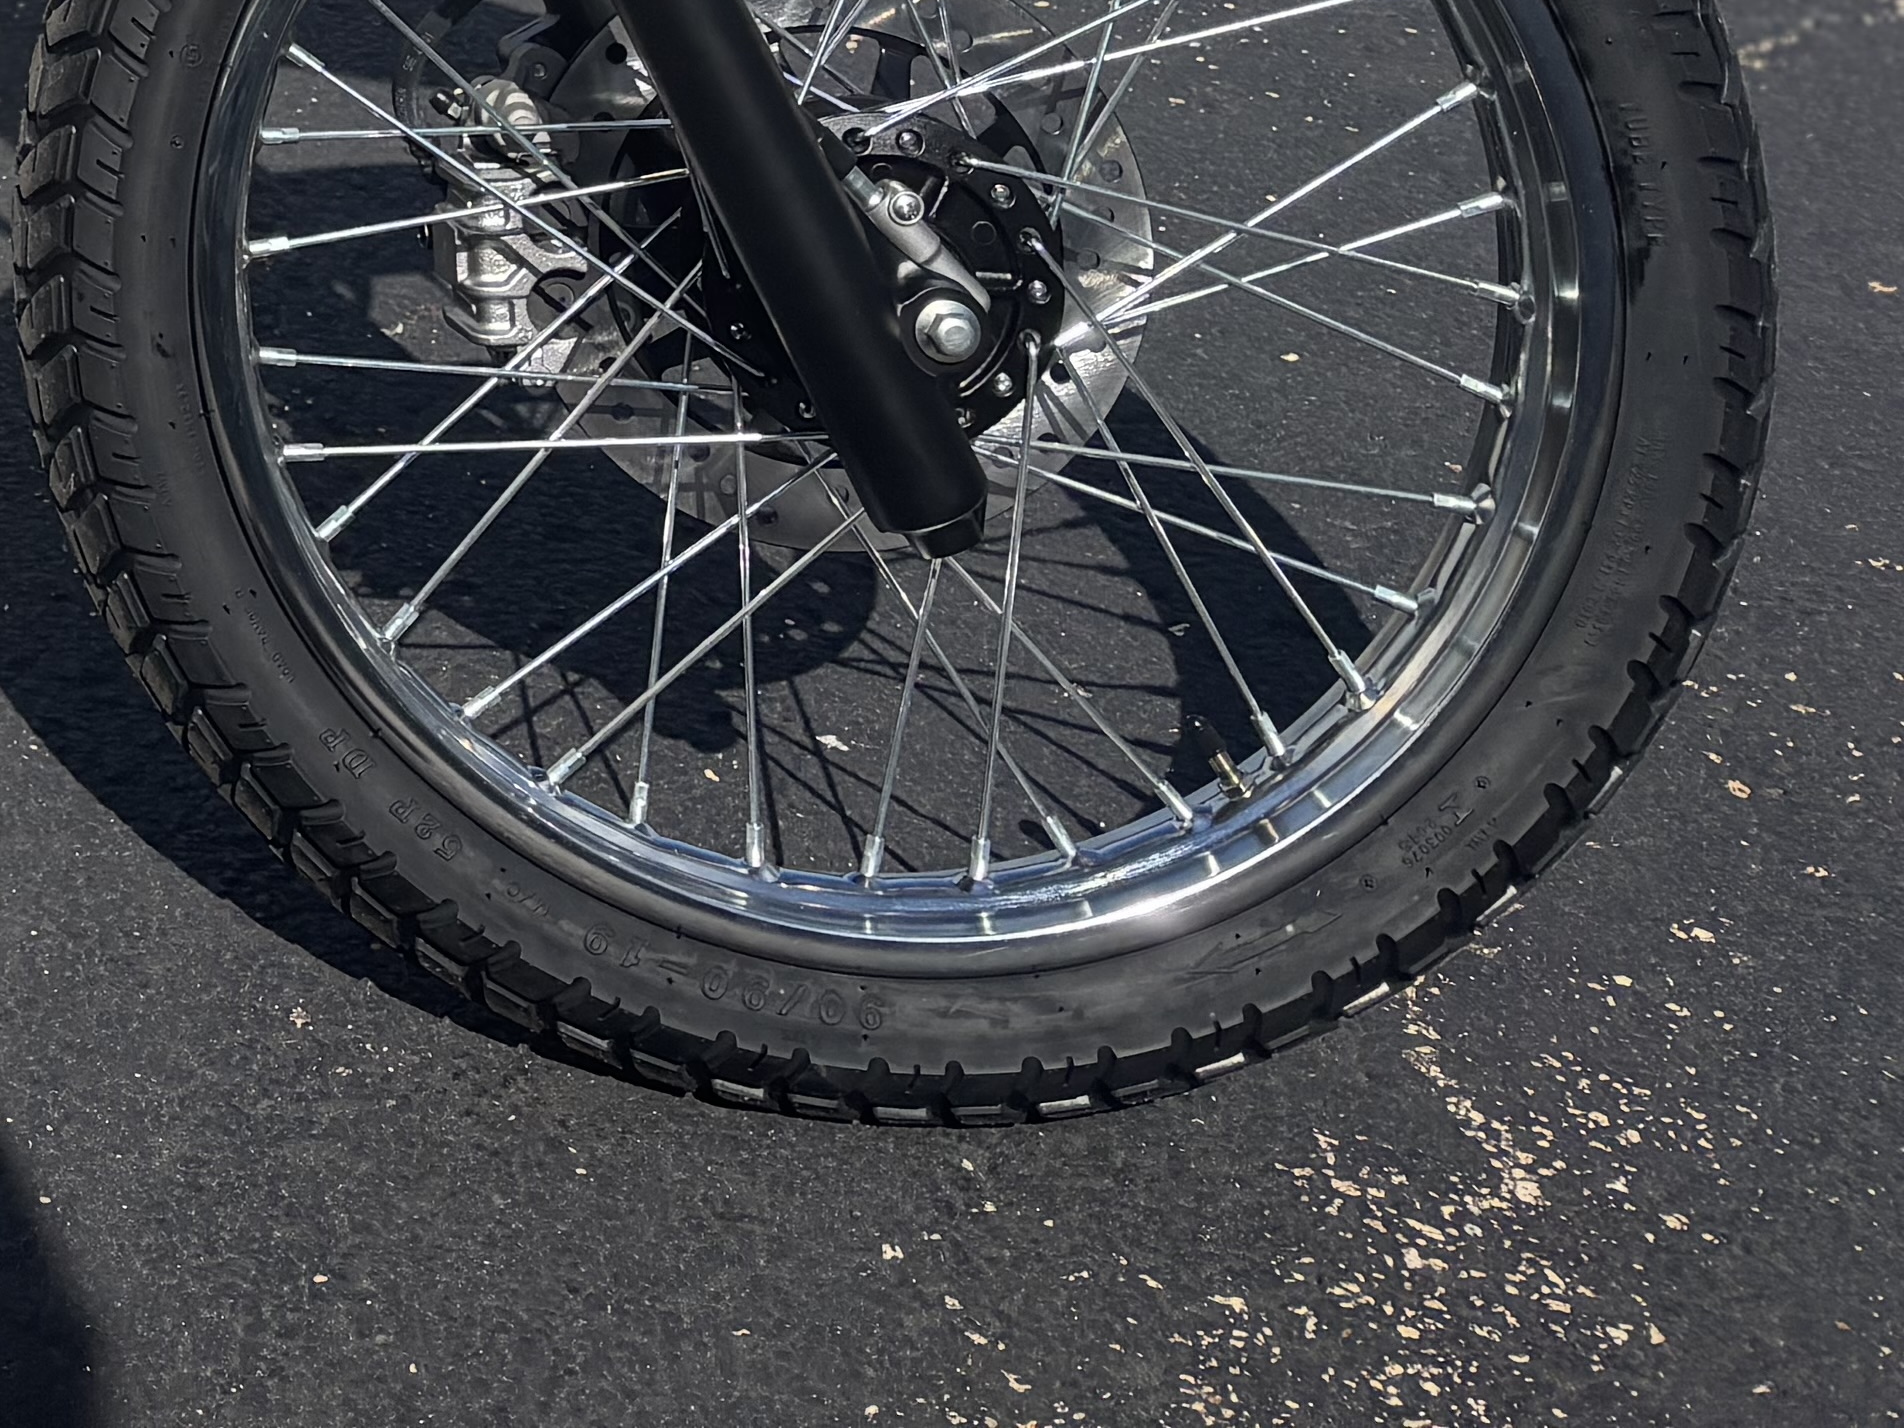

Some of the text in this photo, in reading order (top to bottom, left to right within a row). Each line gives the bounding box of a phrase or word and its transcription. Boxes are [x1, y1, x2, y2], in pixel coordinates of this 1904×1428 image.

[315, 720, 377, 782] DP
[383, 790, 466, 864] 52P
[578, 918, 883, 1030] 90/90-19
